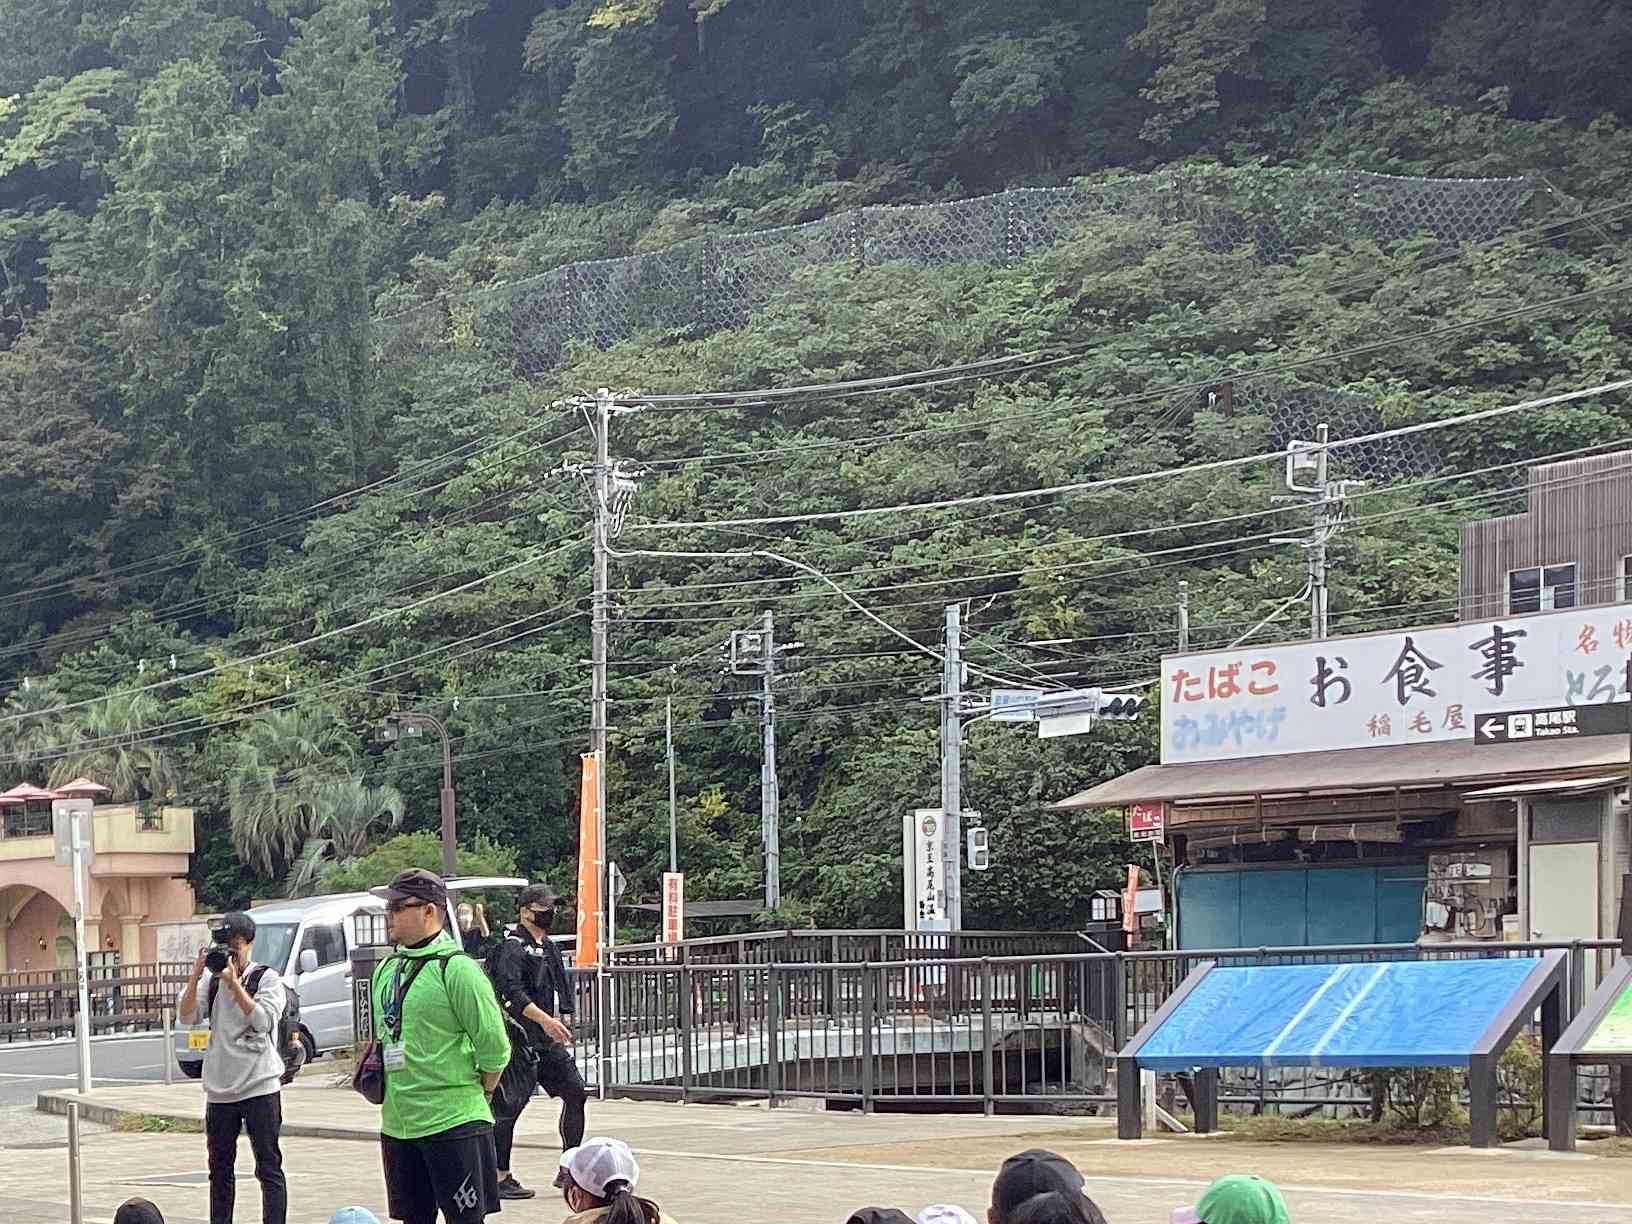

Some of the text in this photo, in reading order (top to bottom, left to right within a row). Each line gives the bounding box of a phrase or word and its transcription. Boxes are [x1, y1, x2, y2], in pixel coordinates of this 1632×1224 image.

[1171, 659, 1280, 704] たばこ
[1309, 624, 1528, 708] お食事
[1171, 706, 1288, 753] おみやげ
[1367, 703, 1467, 738] 稲毛屋
[1535, 710, 1577, 725] 高尾駅
[925, 841, 936, 920] 京王高尾山温
